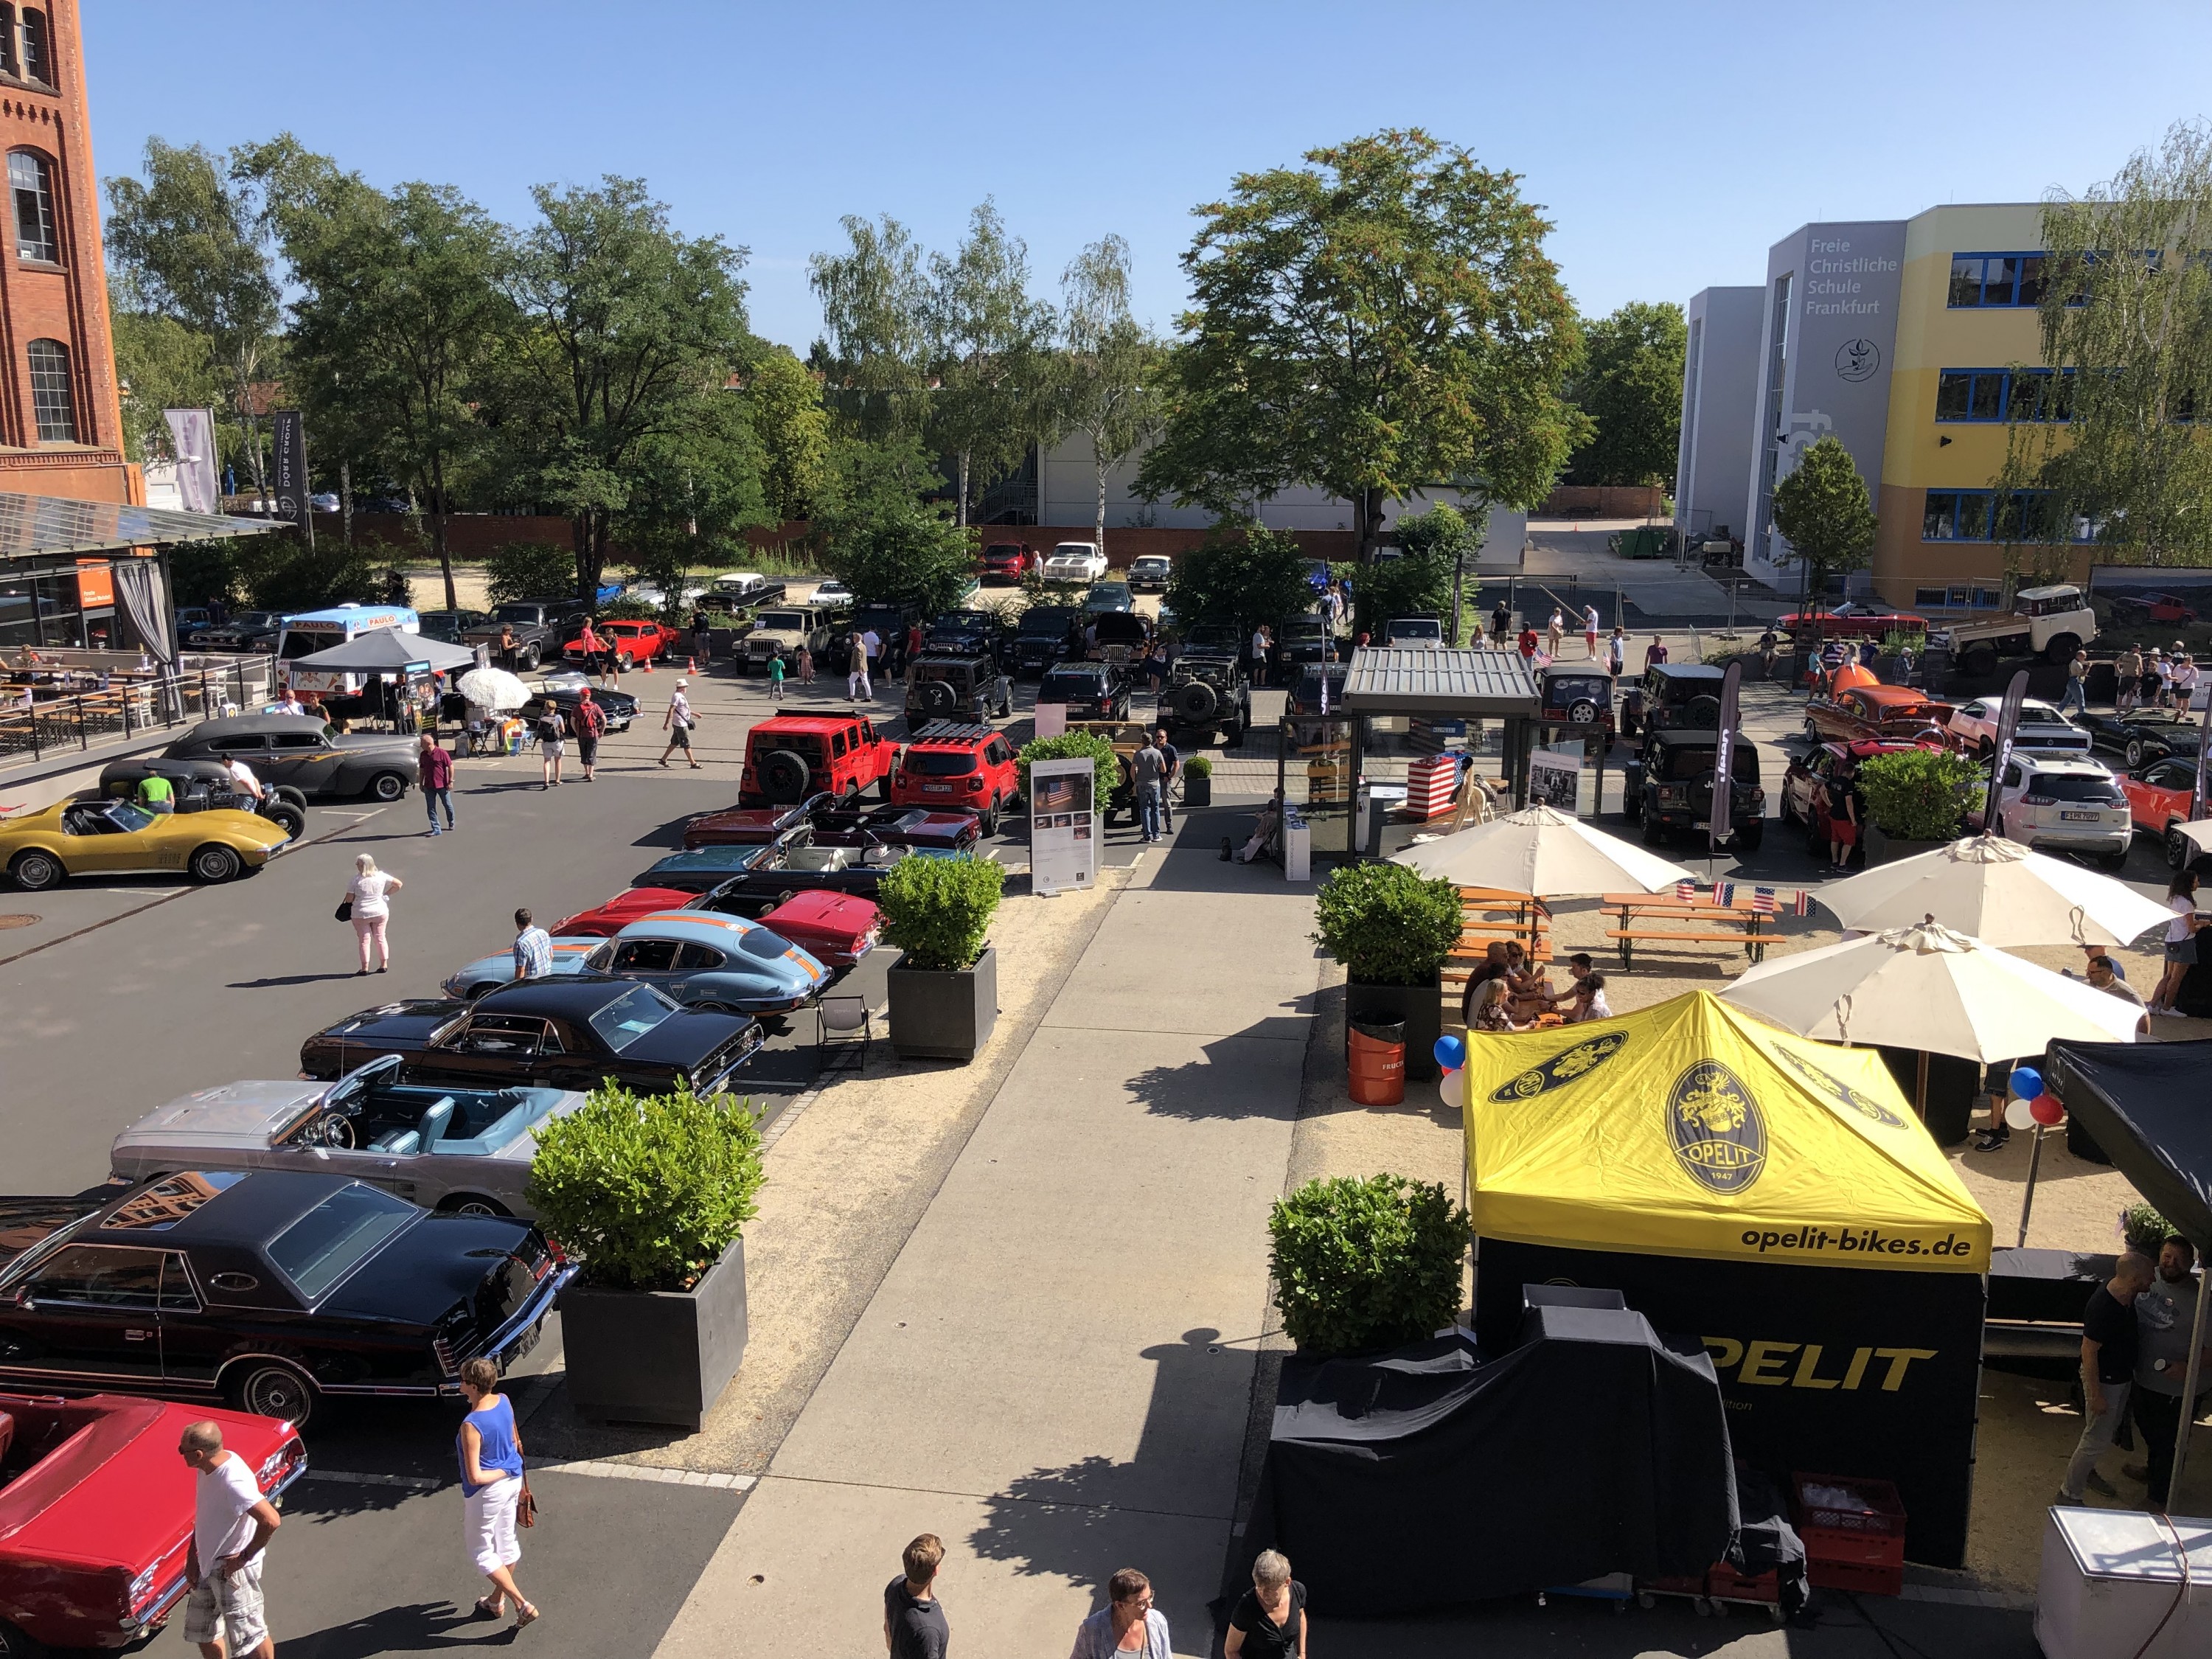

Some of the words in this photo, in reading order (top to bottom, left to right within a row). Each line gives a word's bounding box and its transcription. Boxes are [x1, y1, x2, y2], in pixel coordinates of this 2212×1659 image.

[1811, 238, 1850, 253] Freie
[1810, 257, 1897, 274] Christliche
[1808, 279, 1861, 294] Schule
[1806, 299, 1879, 315] Frankfurt
[369, 616, 395, 626] PAULO
[1704, 780, 1714, 788] Je
[1688, 1144, 1750, 1165] OPELIT
[1711, 1172, 1733, 1180] 1947
[1741, 1225, 1971, 1256] opelit-bikes.de
[1700, 1335, 1939, 1391] PELIT
